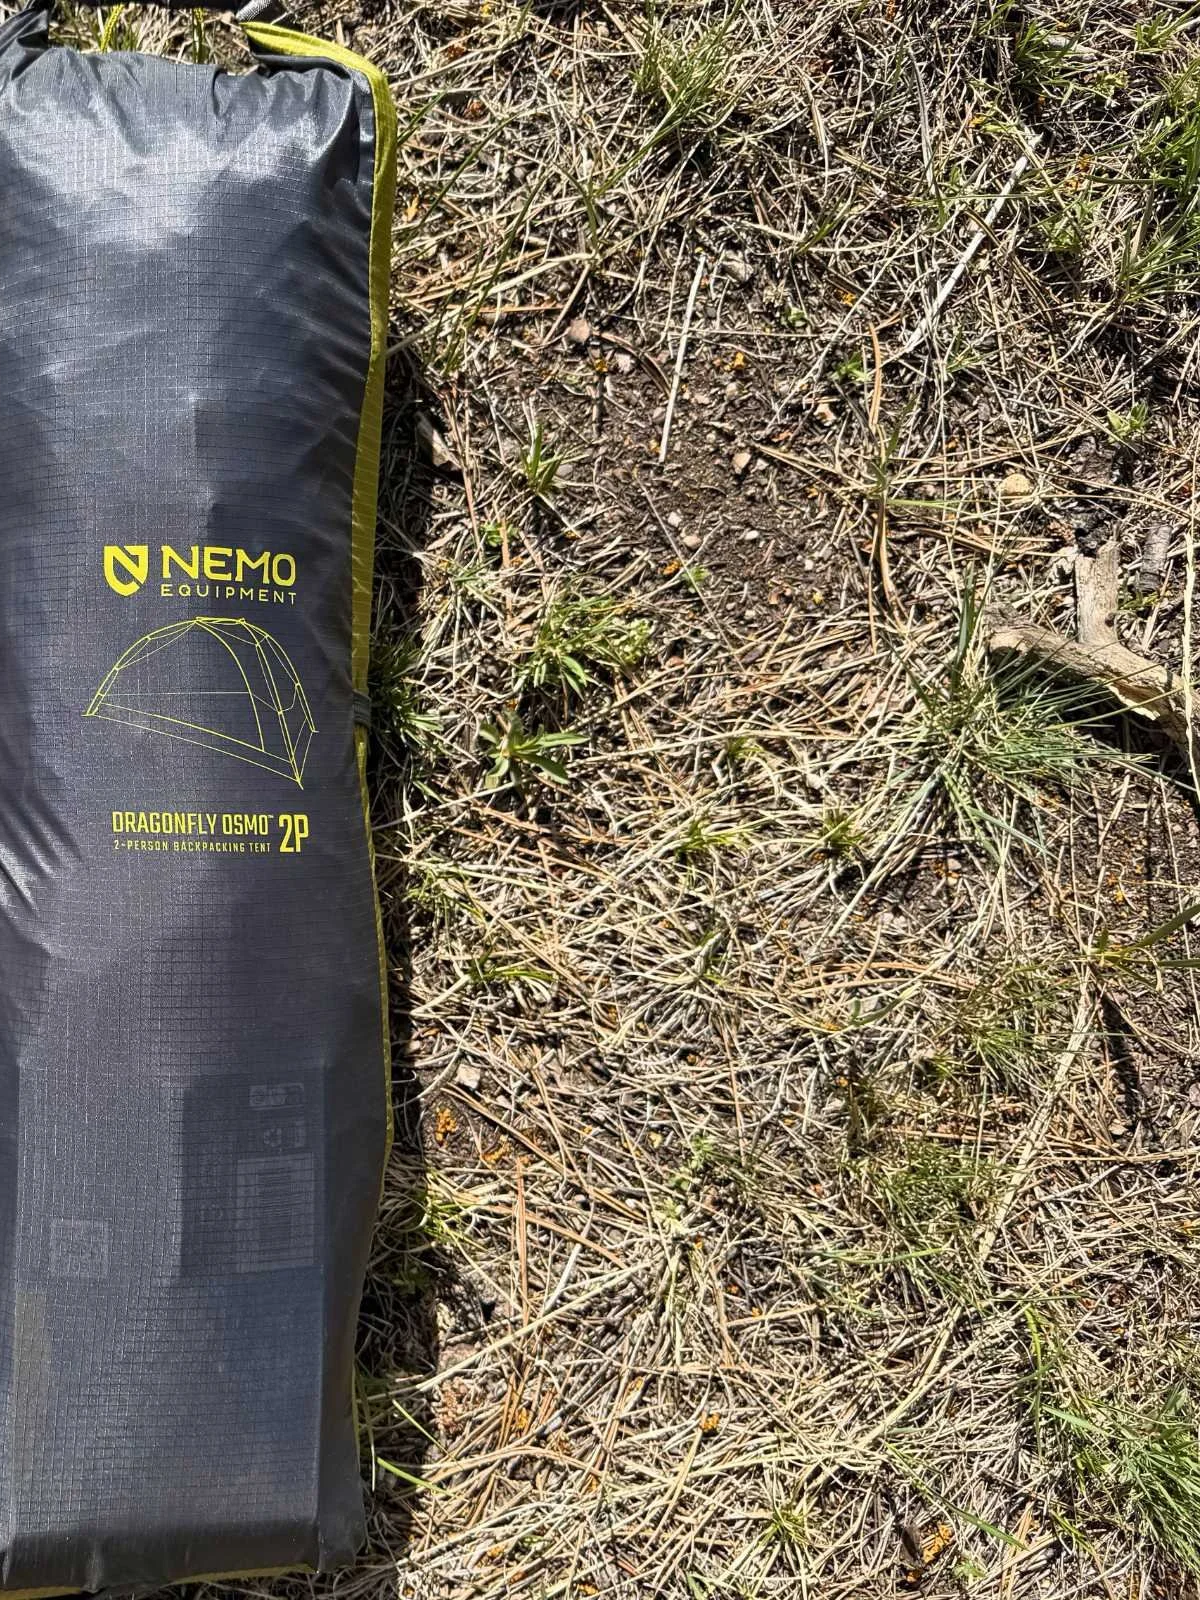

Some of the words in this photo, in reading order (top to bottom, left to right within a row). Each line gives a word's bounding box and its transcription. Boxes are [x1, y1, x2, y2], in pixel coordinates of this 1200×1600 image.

[160, 545, 297, 587] NEMO
[160, 583, 298, 605] EQUIPMENT
[111, 811, 218, 835] DRAGONFLY
[278, 814, 309, 853] 2P
[113, 839, 169, 851] 2-PERSON
[173, 841, 246, 853] BACKPACKING
[248, 842, 272, 853] TENT
